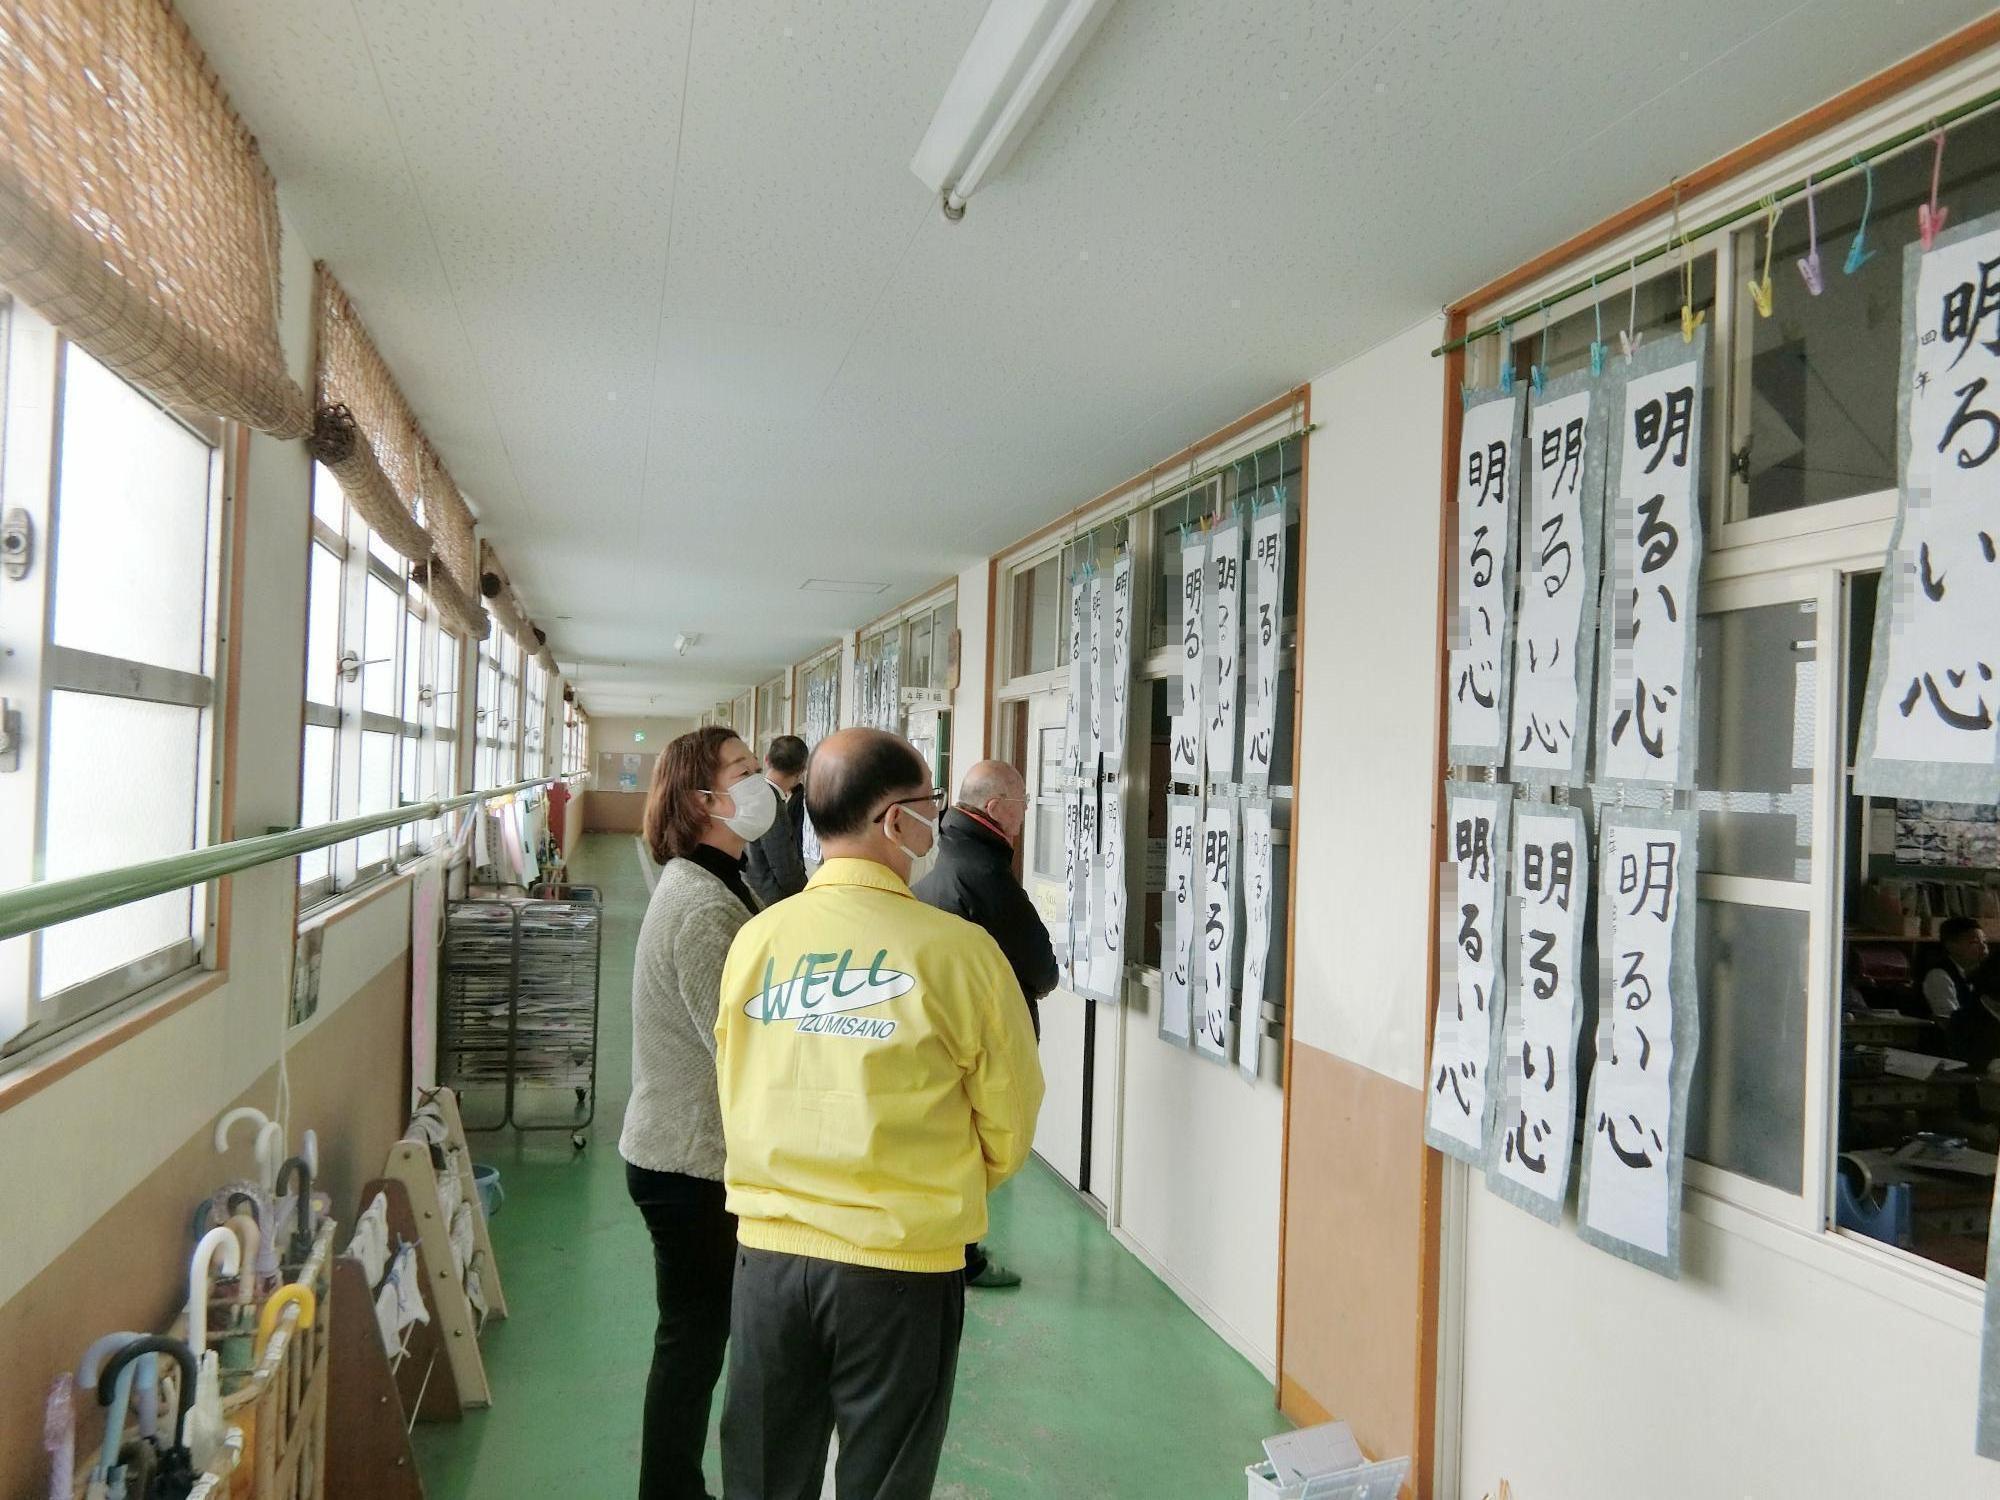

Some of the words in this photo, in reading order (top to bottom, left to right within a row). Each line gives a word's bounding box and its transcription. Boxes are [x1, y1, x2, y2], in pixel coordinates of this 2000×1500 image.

[1520, 417, 1584, 753] 明るい心
[762, 948, 903, 1025] WELL
[797, 1014, 896, 1039] IZUMISANO
[1506, 842, 1573, 1174] 明るい心
